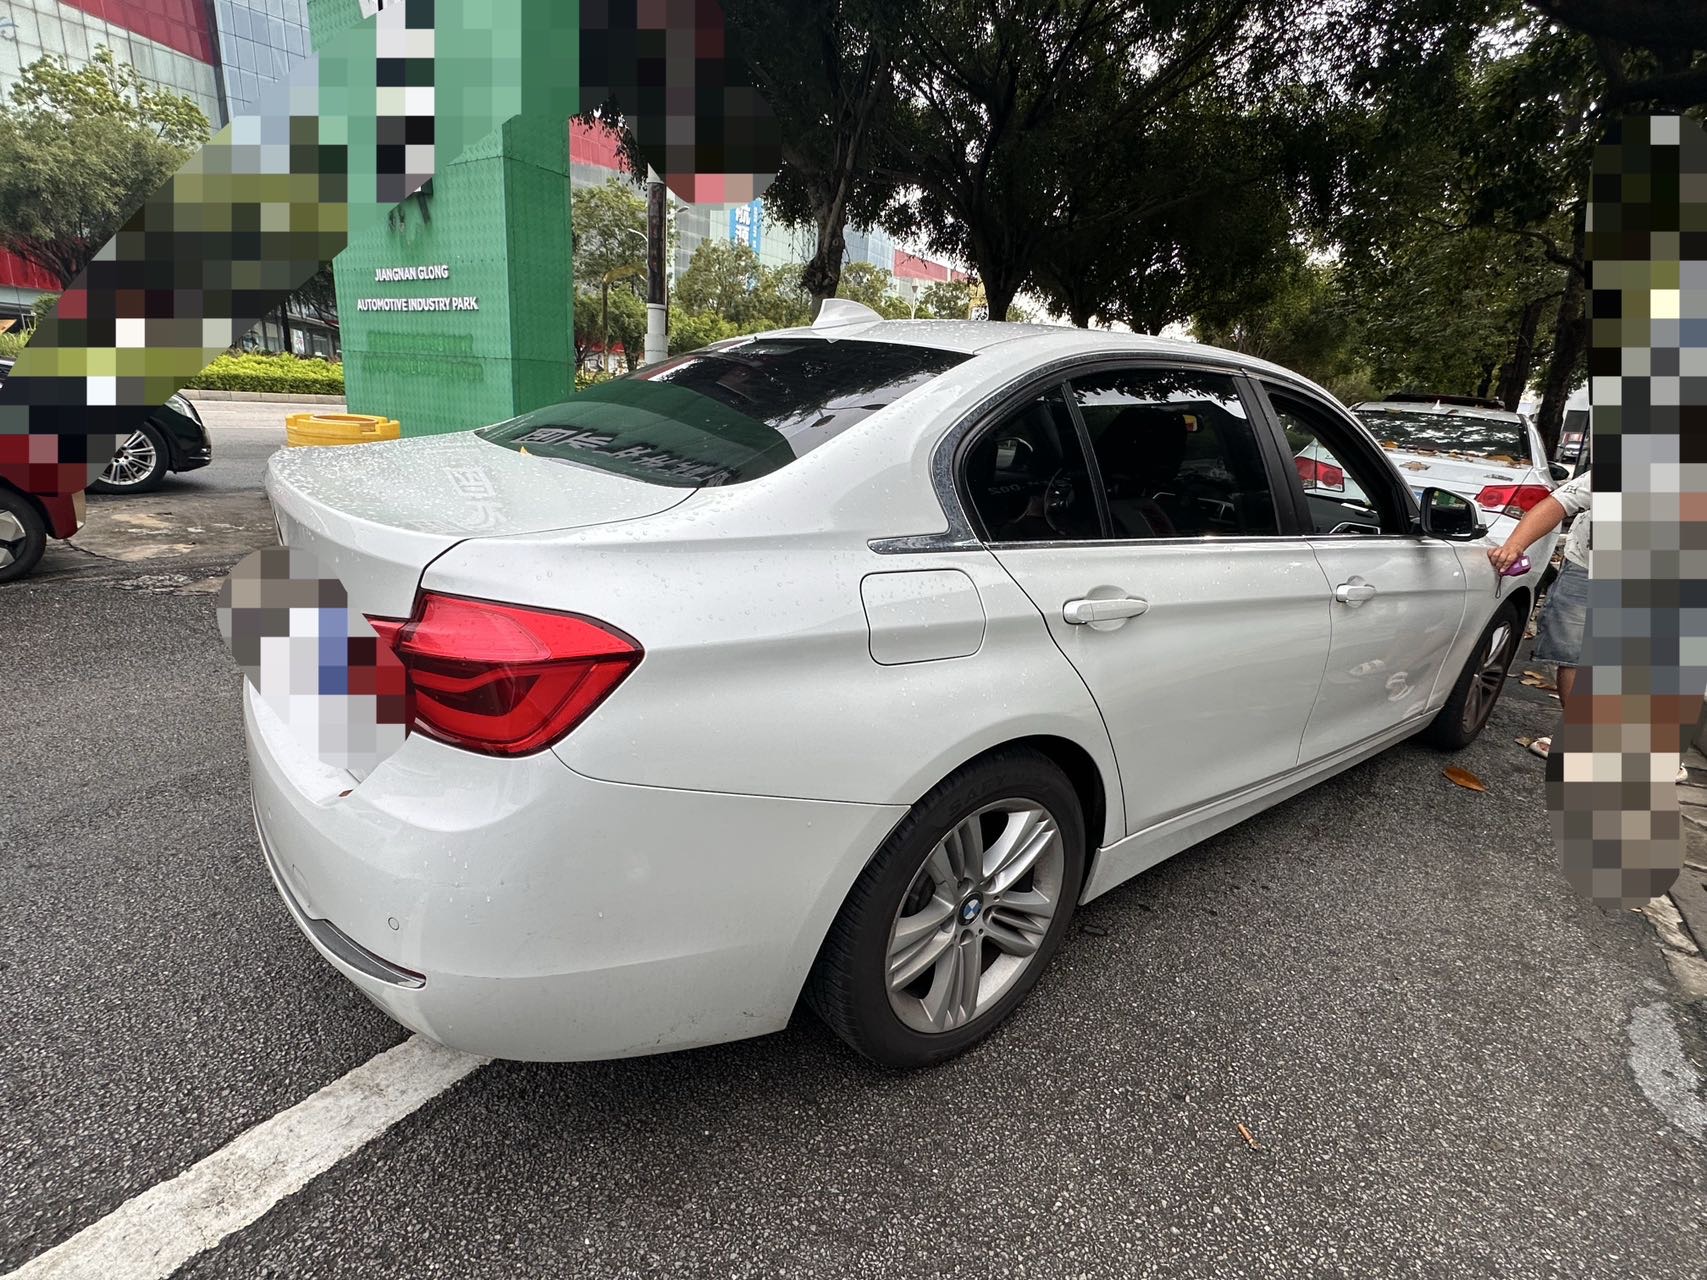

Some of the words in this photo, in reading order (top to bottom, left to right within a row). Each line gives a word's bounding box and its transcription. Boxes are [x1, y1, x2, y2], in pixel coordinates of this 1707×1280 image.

[375, 267, 416, 281] JIANGNAN
[417, 265, 449, 280] GLONG
[357, 298, 408, 311] AUTOMOTIVE
[408, 298, 451, 311] INDUSTRY
[452, 297, 479, 310] PARK
